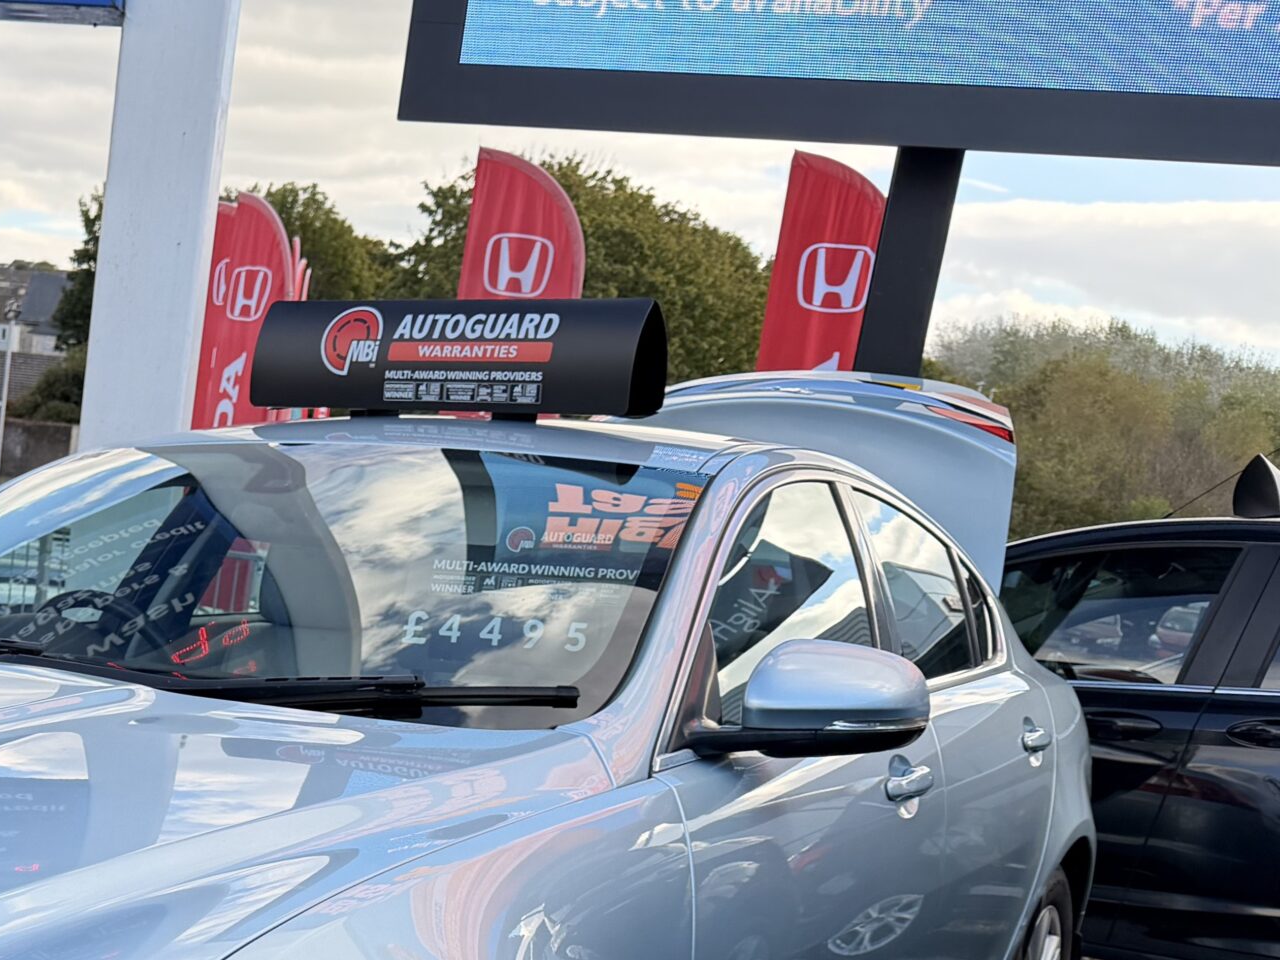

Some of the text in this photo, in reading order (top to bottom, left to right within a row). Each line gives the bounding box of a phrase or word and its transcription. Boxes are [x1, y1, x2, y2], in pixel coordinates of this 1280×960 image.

[393, 313, 560, 340] AUTOGUARD
[418, 345, 518, 358] WARRANTIES
[384, 370, 543, 382] MULTI-AWARD WINNING PROVIDERS
[540, 531, 614, 545] AUTOGUARD
[433, 559, 641, 581] MULTI-AWARD WINNING PROV
[431, 583, 475, 594] WINNER
